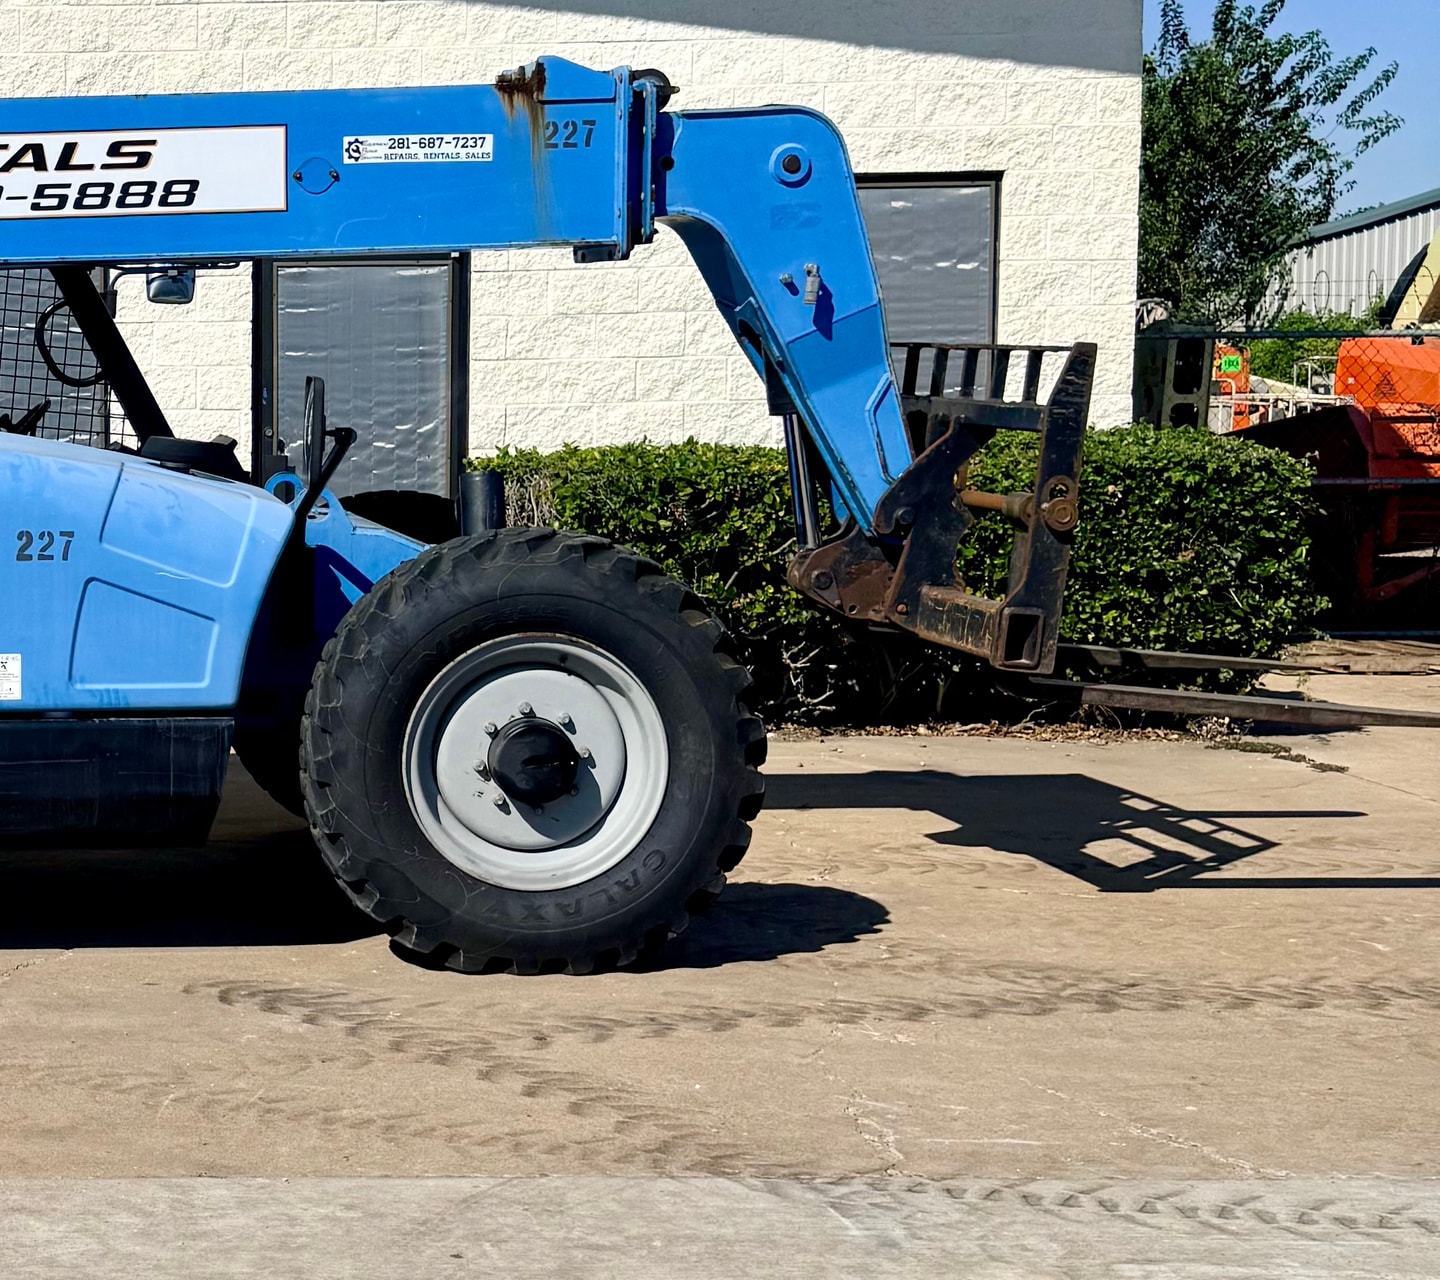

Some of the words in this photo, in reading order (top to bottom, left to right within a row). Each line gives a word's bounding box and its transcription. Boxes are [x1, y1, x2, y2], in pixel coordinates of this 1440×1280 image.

[388, 137, 486, 150] 281-687-7237
[544, 120, 596, 148] 227
[16, 530, 75, 562] 227
